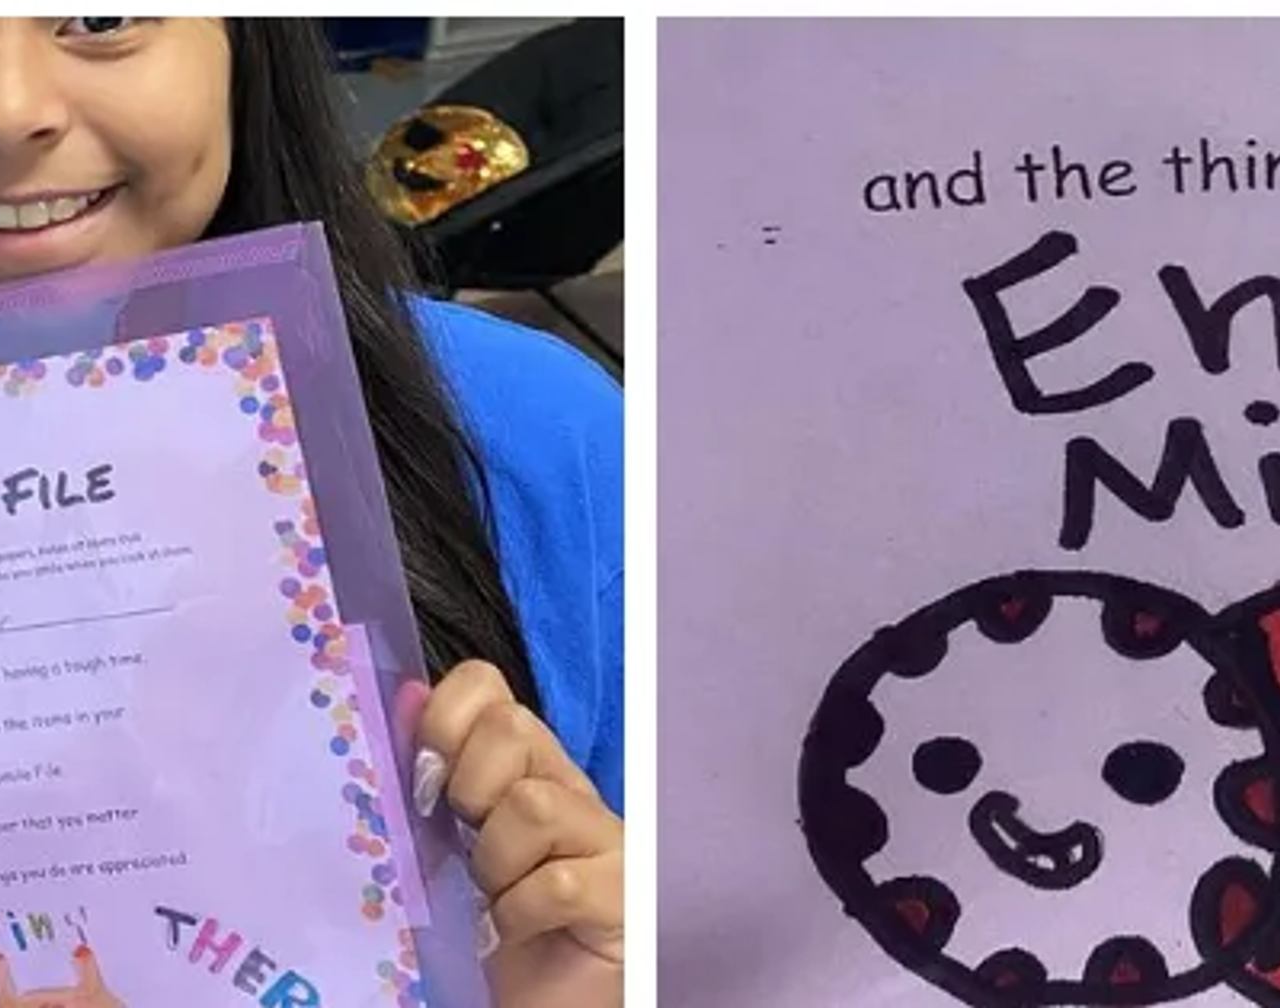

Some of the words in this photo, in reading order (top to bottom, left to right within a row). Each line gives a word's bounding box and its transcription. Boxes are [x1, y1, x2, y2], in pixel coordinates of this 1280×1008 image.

[863, 149, 987, 213] and
[1014, 144, 1138, 203] the
[0, 463, 117, 517] FILE
